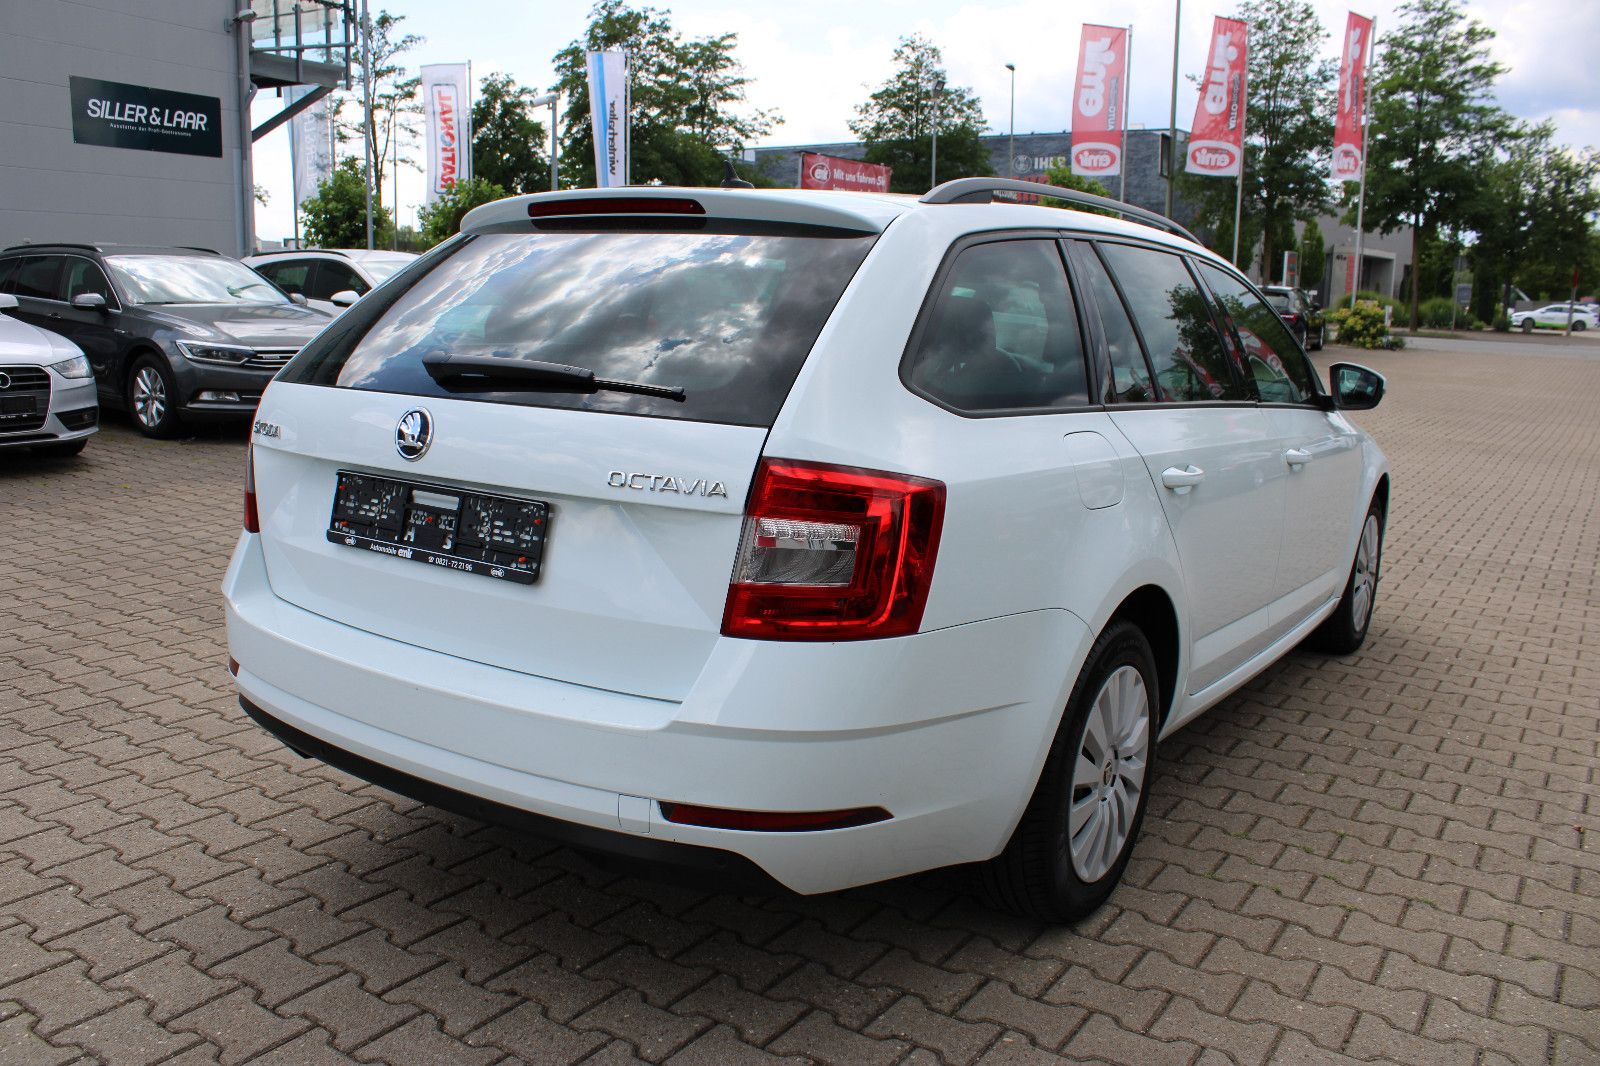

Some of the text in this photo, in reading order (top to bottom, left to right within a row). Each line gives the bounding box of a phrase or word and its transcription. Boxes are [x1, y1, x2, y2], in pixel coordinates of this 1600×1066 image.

[87, 98, 208, 131] SILLER & LAAR
[607, 470, 728, 499] OCTAVIA
